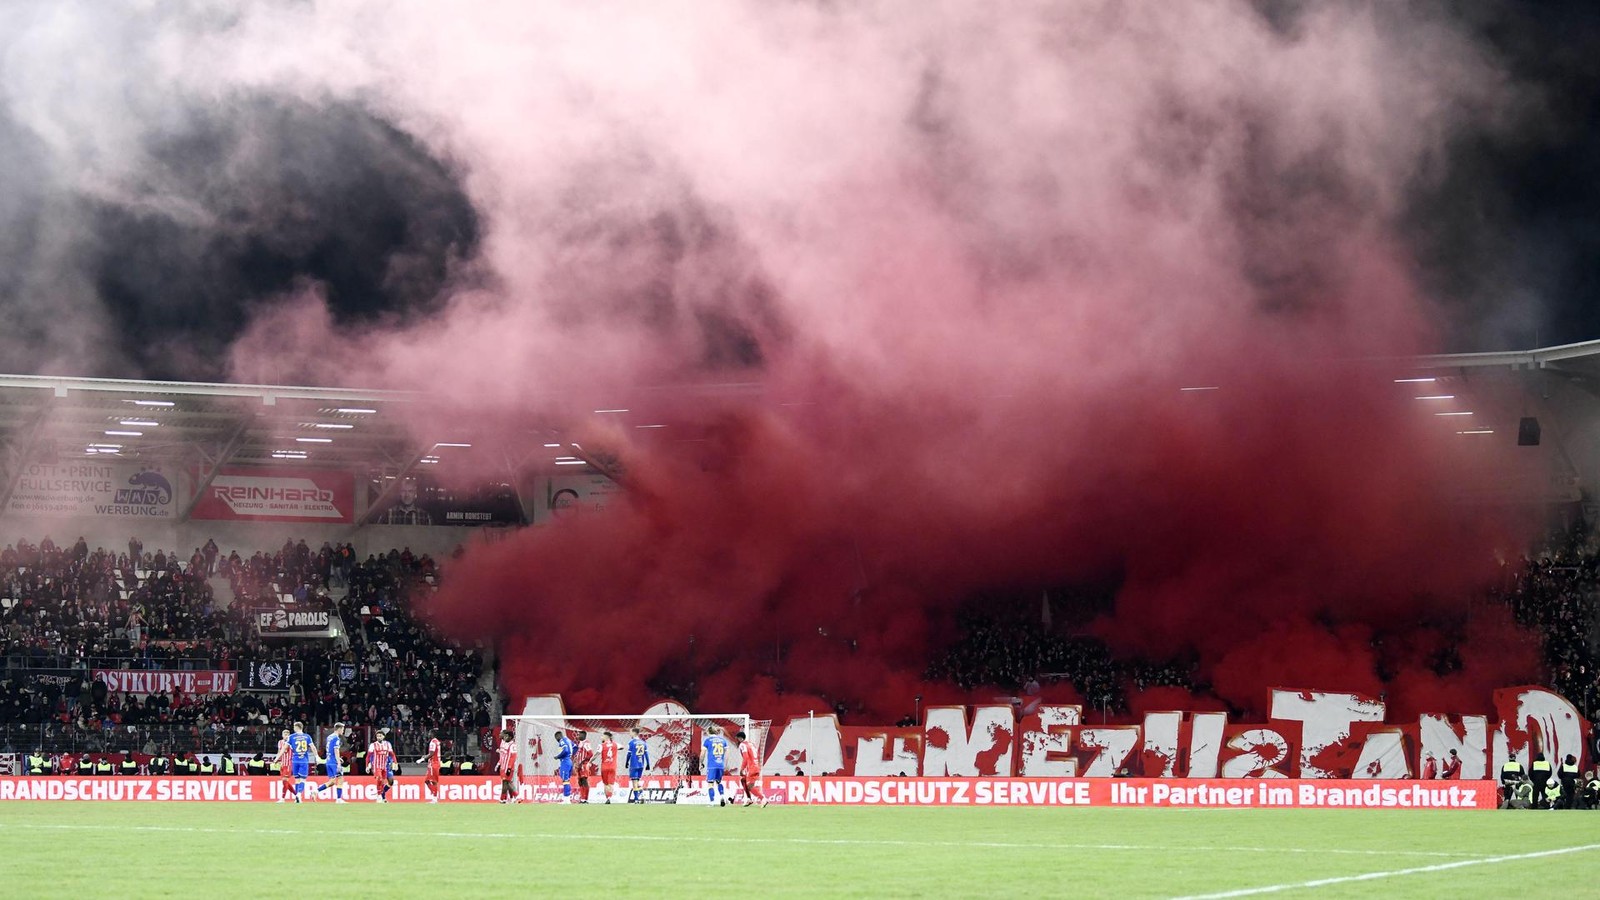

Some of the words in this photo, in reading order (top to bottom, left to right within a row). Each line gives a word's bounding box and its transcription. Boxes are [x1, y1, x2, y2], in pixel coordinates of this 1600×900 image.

[70, 466, 113, 478] PRINT
[20, 479, 112, 492] FULLSERVICE
[94, 505, 169, 517] WERBUNG.de
[269, 502, 299, 510] SANITÄR
[446, 512, 464, 520] ARMIN
[465, 512, 492, 520] ROMSTEDT
[260, 613, 273, 627] EF
[288, 612, 329, 626] PAROLIS
[212, 672, 235, 693] EF
[295, 740, 308, 753] 29
[635, 746, 645, 756] 23
[712, 743, 724, 755] 26
[156, 780, 252, 801] SERVICE
[392, 781, 419, 801] im
[975, 782, 1090, 804] SERVICE
[1111, 783, 1148, 804] Ihr
[1152, 783, 1253, 804] Partner
[1259, 783, 1293, 805] im
[1299, 783, 1477, 806] Brandschutz
